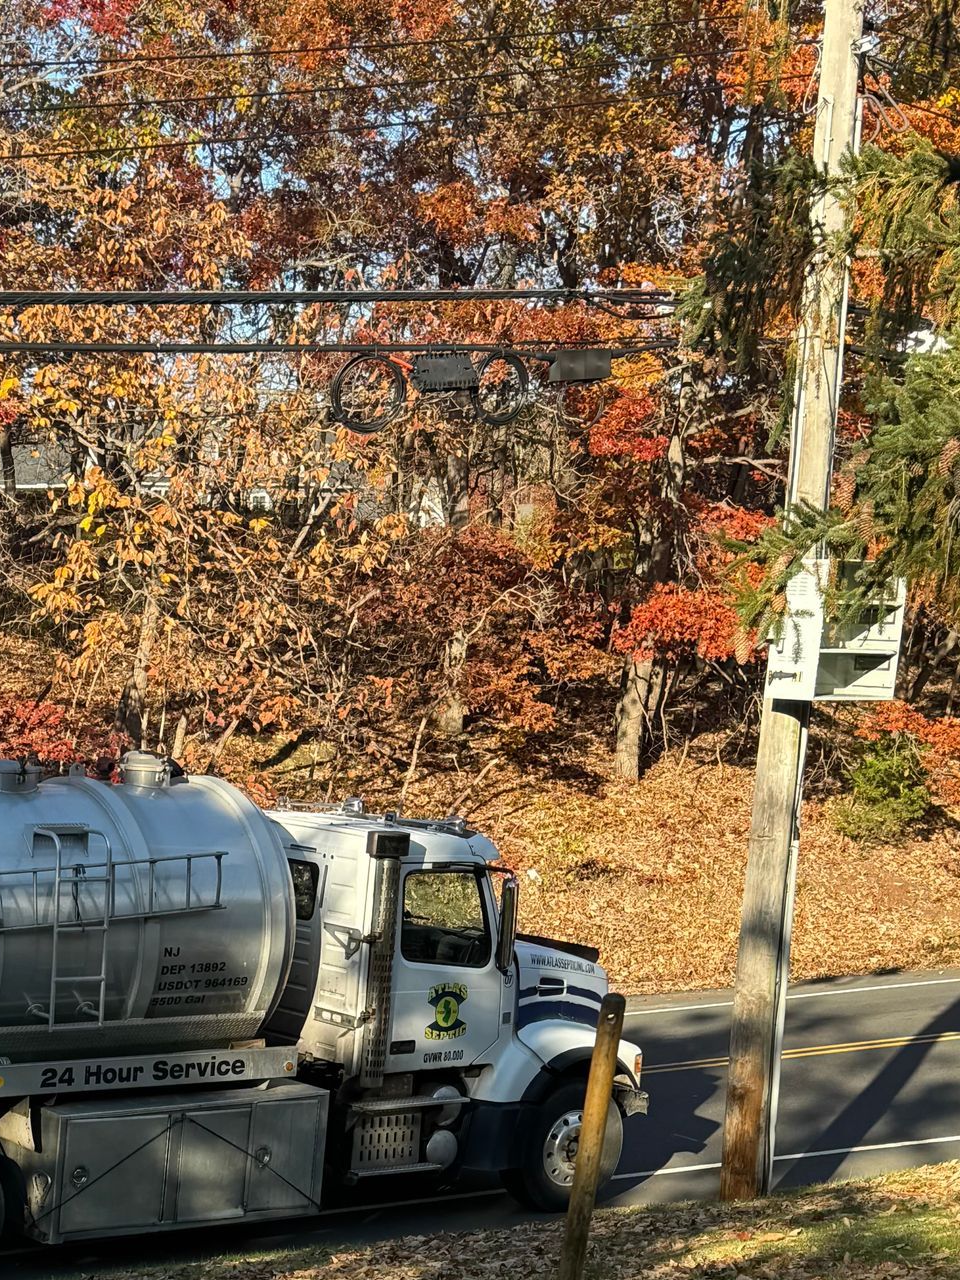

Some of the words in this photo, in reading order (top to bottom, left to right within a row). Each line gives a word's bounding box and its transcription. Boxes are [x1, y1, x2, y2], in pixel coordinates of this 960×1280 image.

[163, 947, 180, 957] NJ
[161, 964, 185, 975] DEP
[158, 980, 201, 991] USDOT
[427, 982, 468, 1002] ATLAS
[424, 1023, 467, 1040] SEPTIC
[423, 1051, 443, 1063] GVWR
[40, 1067, 75, 1088] 24
[85, 1065, 144, 1085] Hour
[152, 1056, 246, 1080] Service
